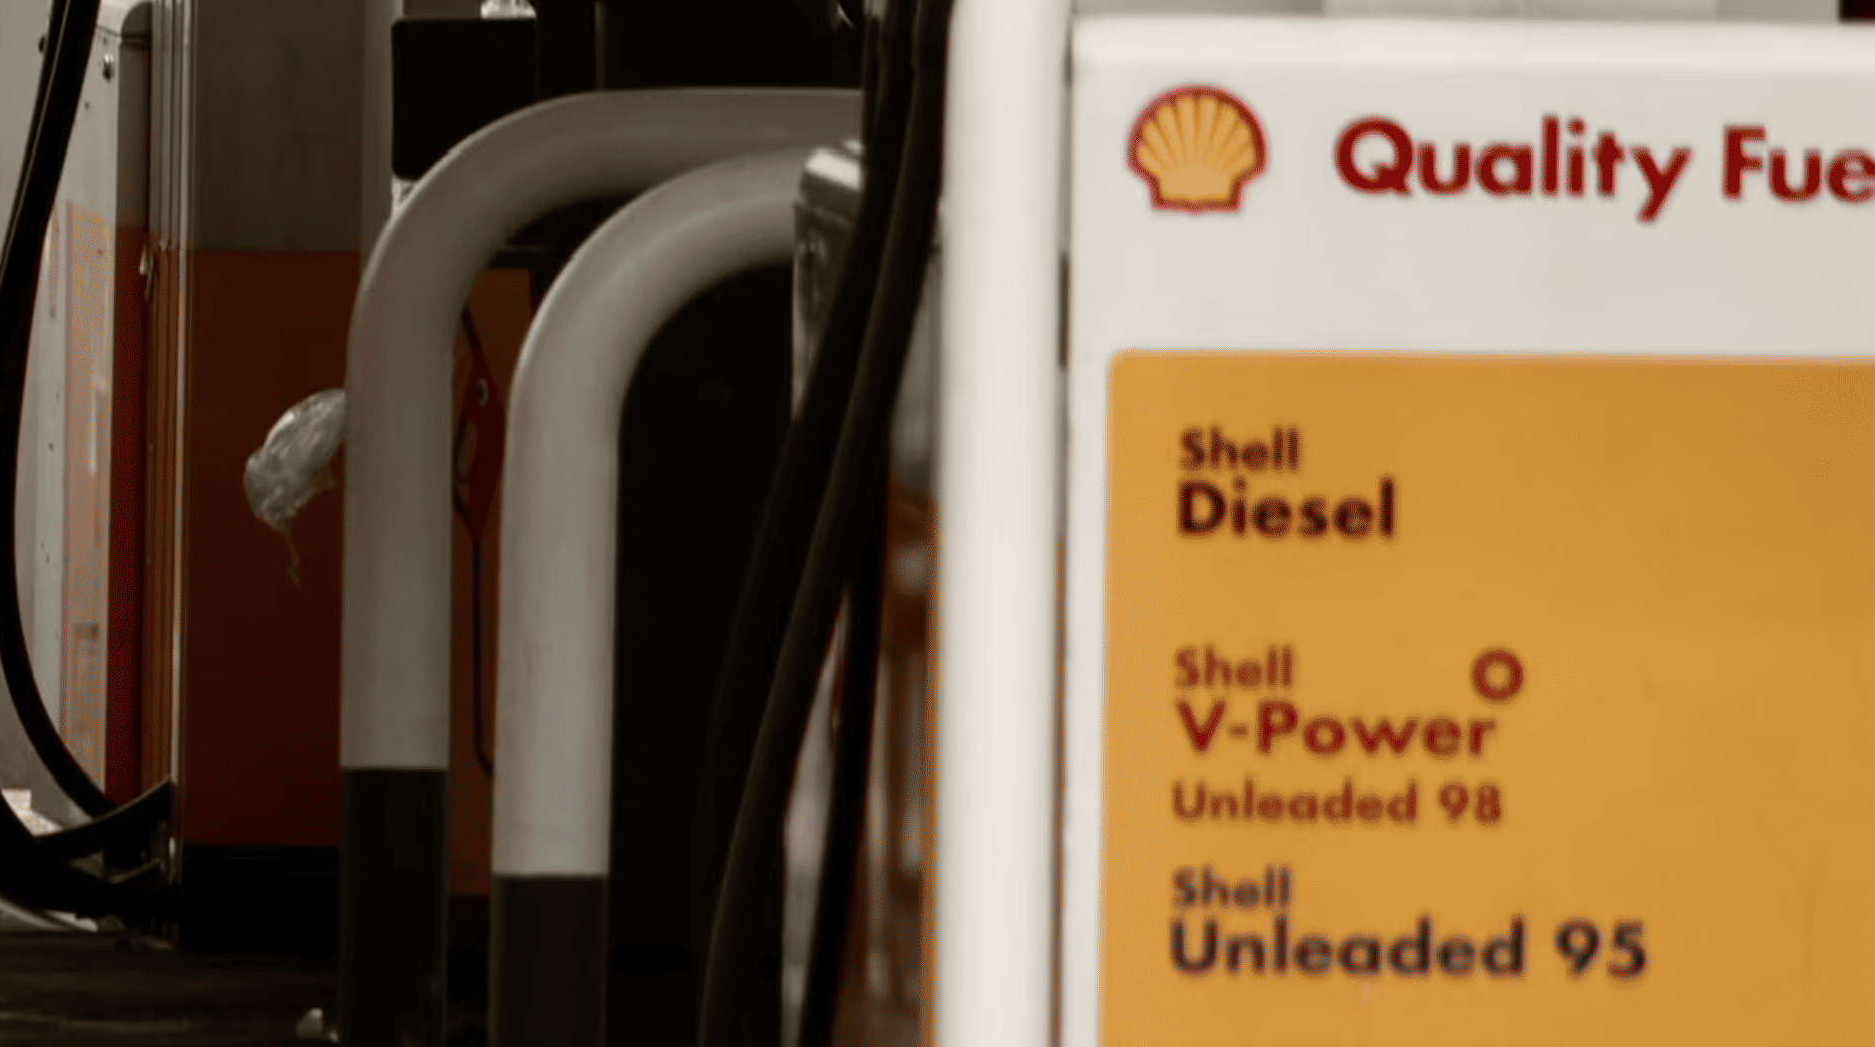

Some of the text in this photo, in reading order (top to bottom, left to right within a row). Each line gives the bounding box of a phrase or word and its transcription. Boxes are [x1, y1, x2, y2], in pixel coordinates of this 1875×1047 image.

[1333, 115, 1692, 224] Quality
[1181, 427, 1300, 472] Shell
[1178, 476, 1395, 540] Diesel
[1174, 644, 1296, 690] Shell
[1178, 699, 1498, 757] V-Power
[1171, 775, 1504, 828] Unleaded 98
[1171, 864, 1295, 909] Shell
[1170, 913, 1649, 981] Unleaded 95
